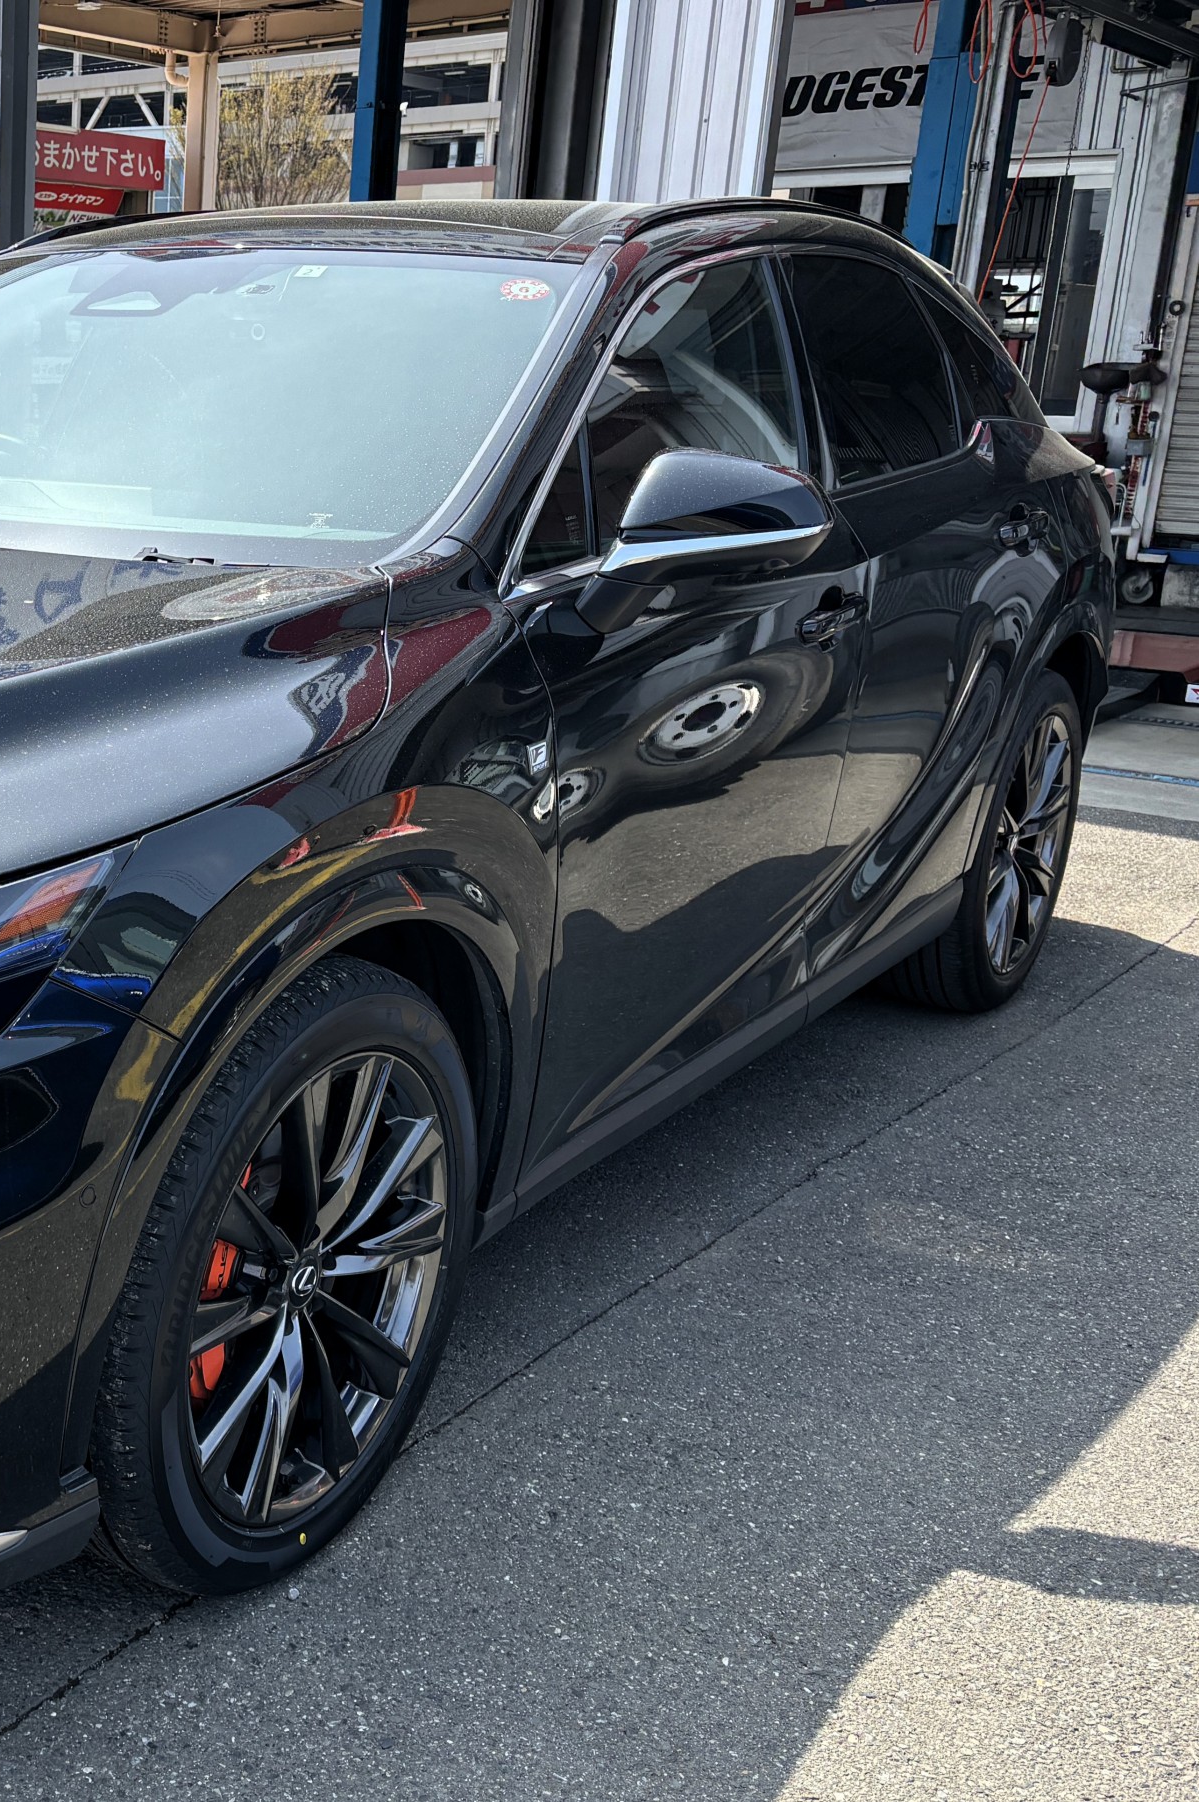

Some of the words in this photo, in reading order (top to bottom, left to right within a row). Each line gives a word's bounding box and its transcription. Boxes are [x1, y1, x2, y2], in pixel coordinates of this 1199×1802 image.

[58, 193, 104, 206] タイヤマン
